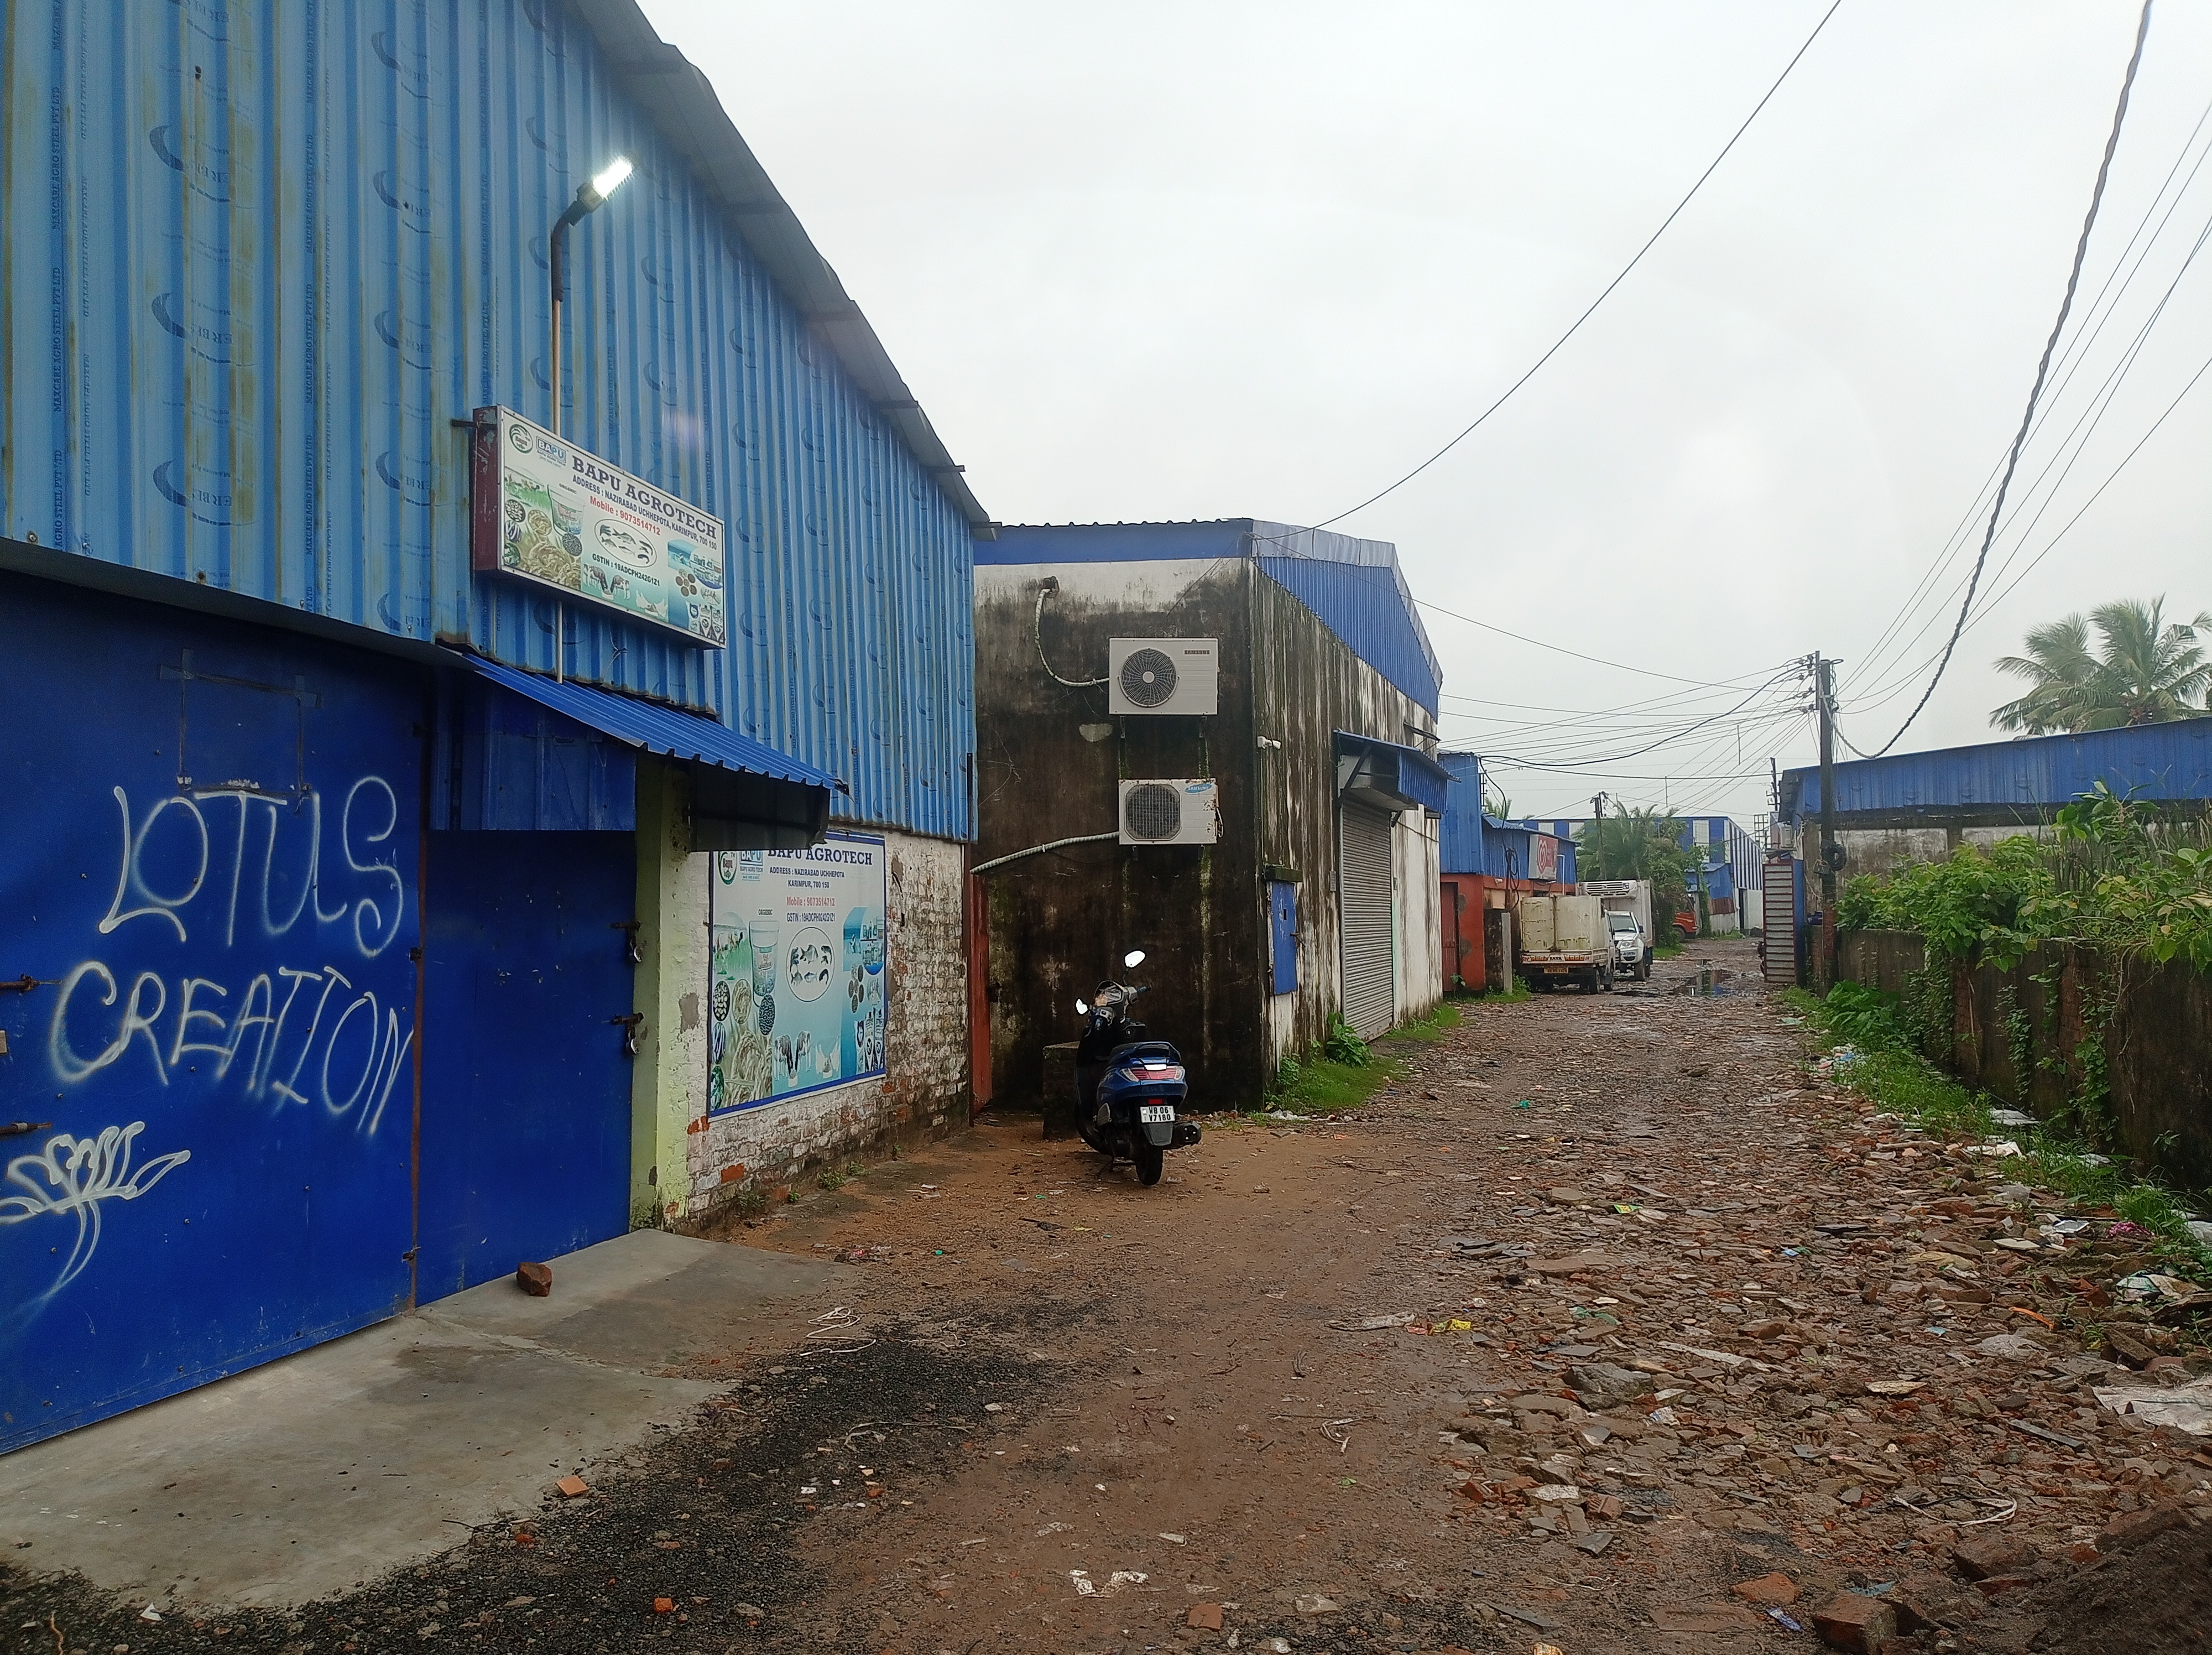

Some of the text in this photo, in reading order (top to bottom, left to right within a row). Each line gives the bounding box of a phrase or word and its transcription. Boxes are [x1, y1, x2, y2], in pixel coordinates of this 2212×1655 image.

[51, 87, 60, 105] LTD
[53, 268, 61, 412] MAXCARE AGRO STEEL PVT LTD
[538, 440, 564, 459] BAPU
[54, 470, 62, 487] PVT
[54, 491, 62, 518] STEEL
[572, 455, 717, 540] BAPU AGROTECH
[573, 475, 601, 495] ADDRESS
[605, 490, 638, 512] NAZIRABAD
[638, 507, 672, 530] UCHHEPOTA,
[671, 521, 699, 543] KARIMPUR,
[699, 535, 708, 547] 700
[708, 540, 717, 550] 150
[589, 495, 614, 514] Mobile
[620, 511, 661, 536] 9073514712
[54, 520, 62, 548] AGRO
[592, 553, 611, 566] GSTIN
[98, 776, 404, 956] LOTUS
[767, 847, 873, 866] BAPU AGROTECH
[769, 866, 791, 875] ADDRESS
[794, 868, 819, 877] NAZIRABAD
[820, 870, 845, 878] UCHHEPOTA
[788, 880, 812, 888] KARIMPUR,
[786, 897, 803, 906] Mobile
[806, 897, 836, 907] 9073514712
[787, 913, 799, 922] GSTIN
[52, 960, 414, 1137] CREATION
